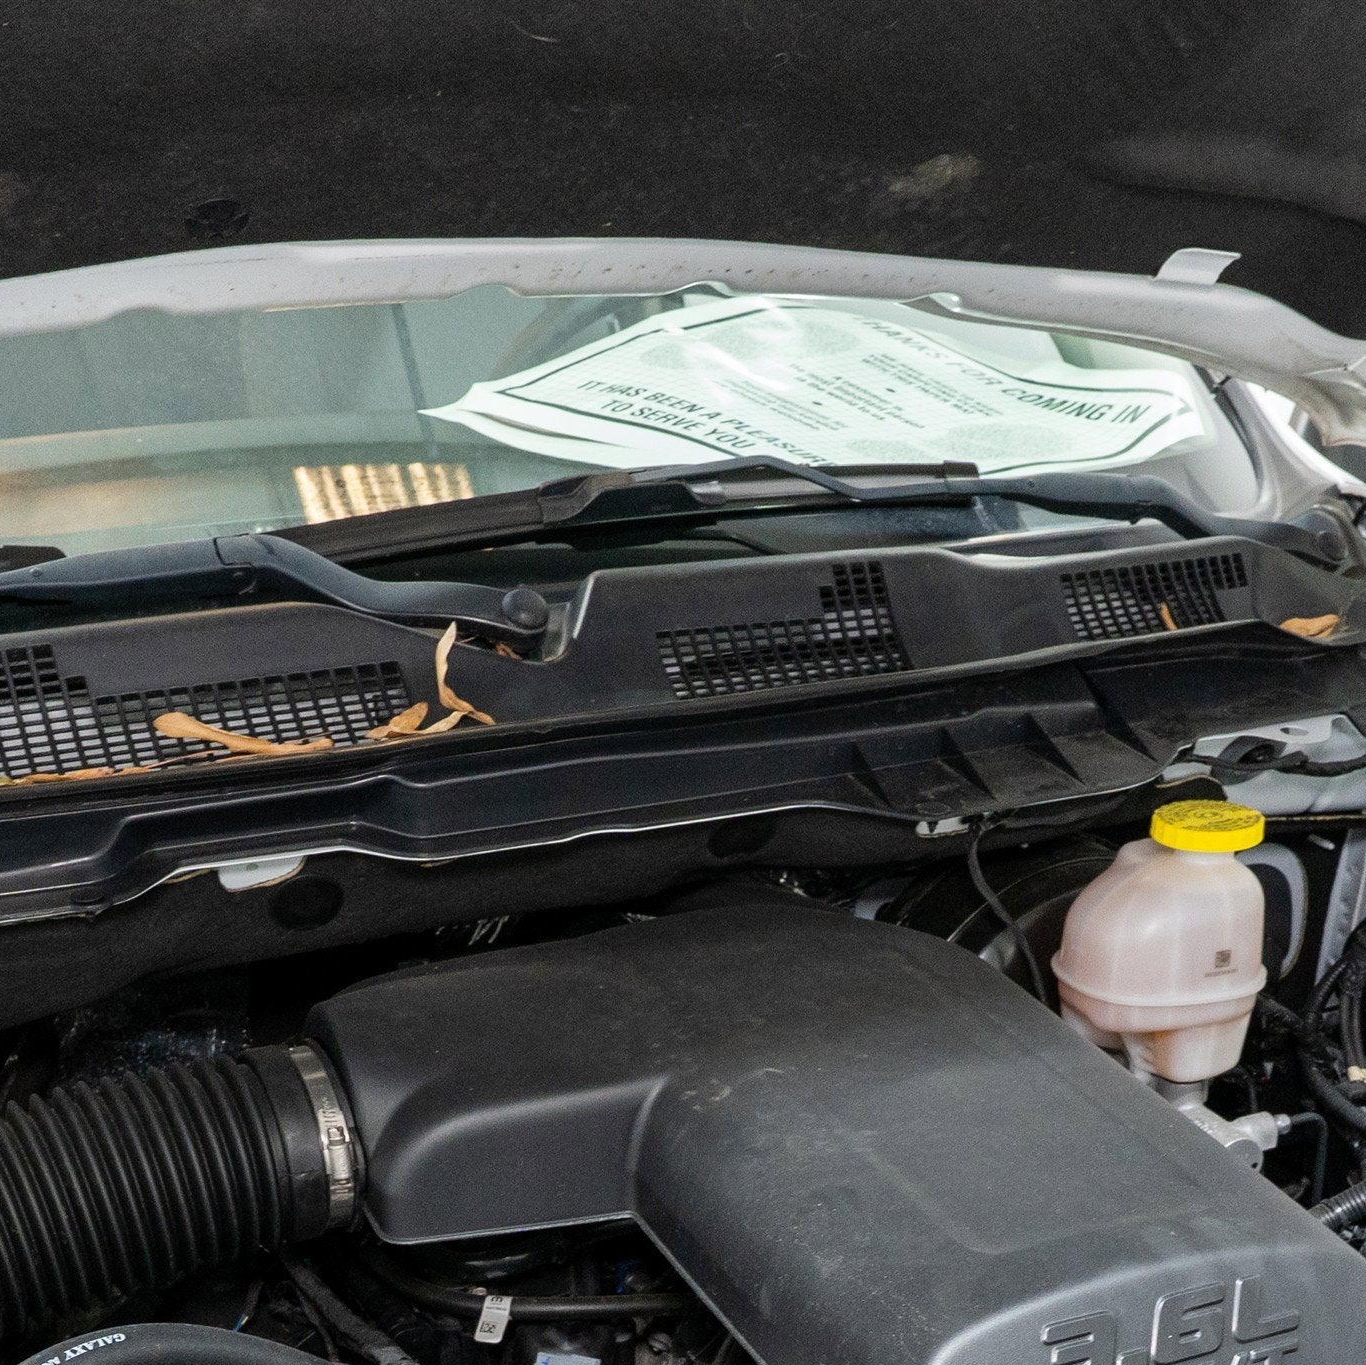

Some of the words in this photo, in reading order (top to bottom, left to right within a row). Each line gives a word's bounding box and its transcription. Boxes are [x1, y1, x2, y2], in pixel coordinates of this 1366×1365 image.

[577, 380, 601, 390] IT
[599, 381, 647, 397] HAS
[644, 391, 705, 413] BEEN
[700, 411, 723, 420] A
[720, 418, 833, 464] PLEASUR
[601, 400, 627, 412] TO
[631, 406, 706, 431] SERVE
[705, 427, 757, 449] YOU
[1001, 387, 1114, 421] COMING
[1111, 404, 1150, 423] IN
[63, 1333, 126, 1361] GALAXY
